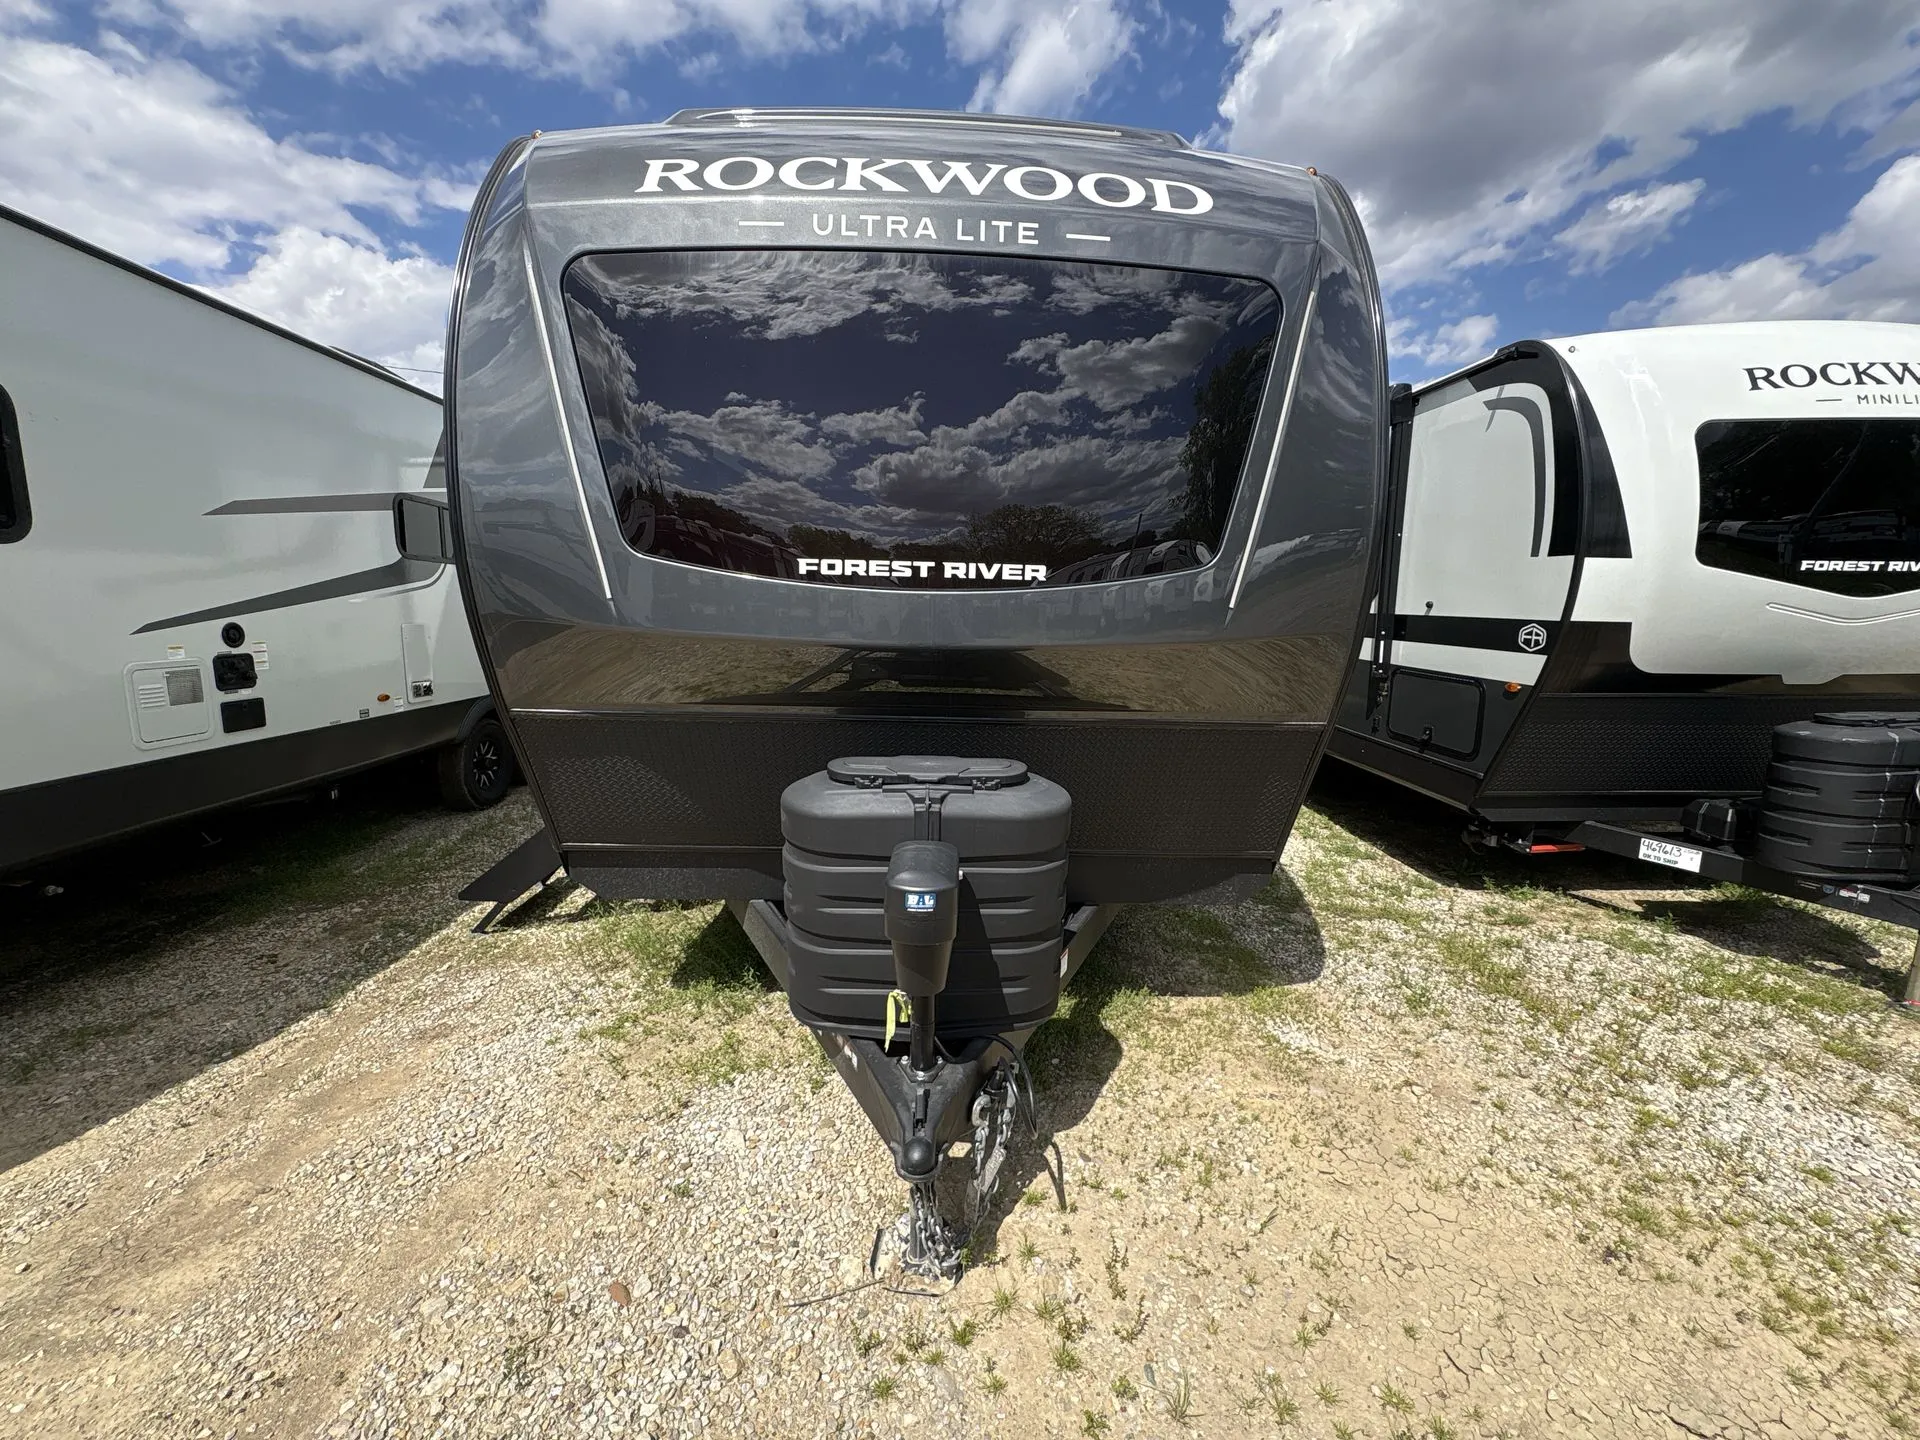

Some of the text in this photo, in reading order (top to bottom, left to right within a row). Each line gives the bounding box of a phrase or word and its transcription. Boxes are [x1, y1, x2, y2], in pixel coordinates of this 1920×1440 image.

[634, 156, 1214, 215] ROCKWOOD
[812, 213, 1039, 245] ULTRA LITE
[1743, 362, 1920, 391] ROCKW
[1856, 394, 1919, 405] MINILI
[796, 558, 1047, 581] FOREST RIVER
[1800, 560, 1885, 572] FOREST
[1642, 840, 1682, 857] 469613
